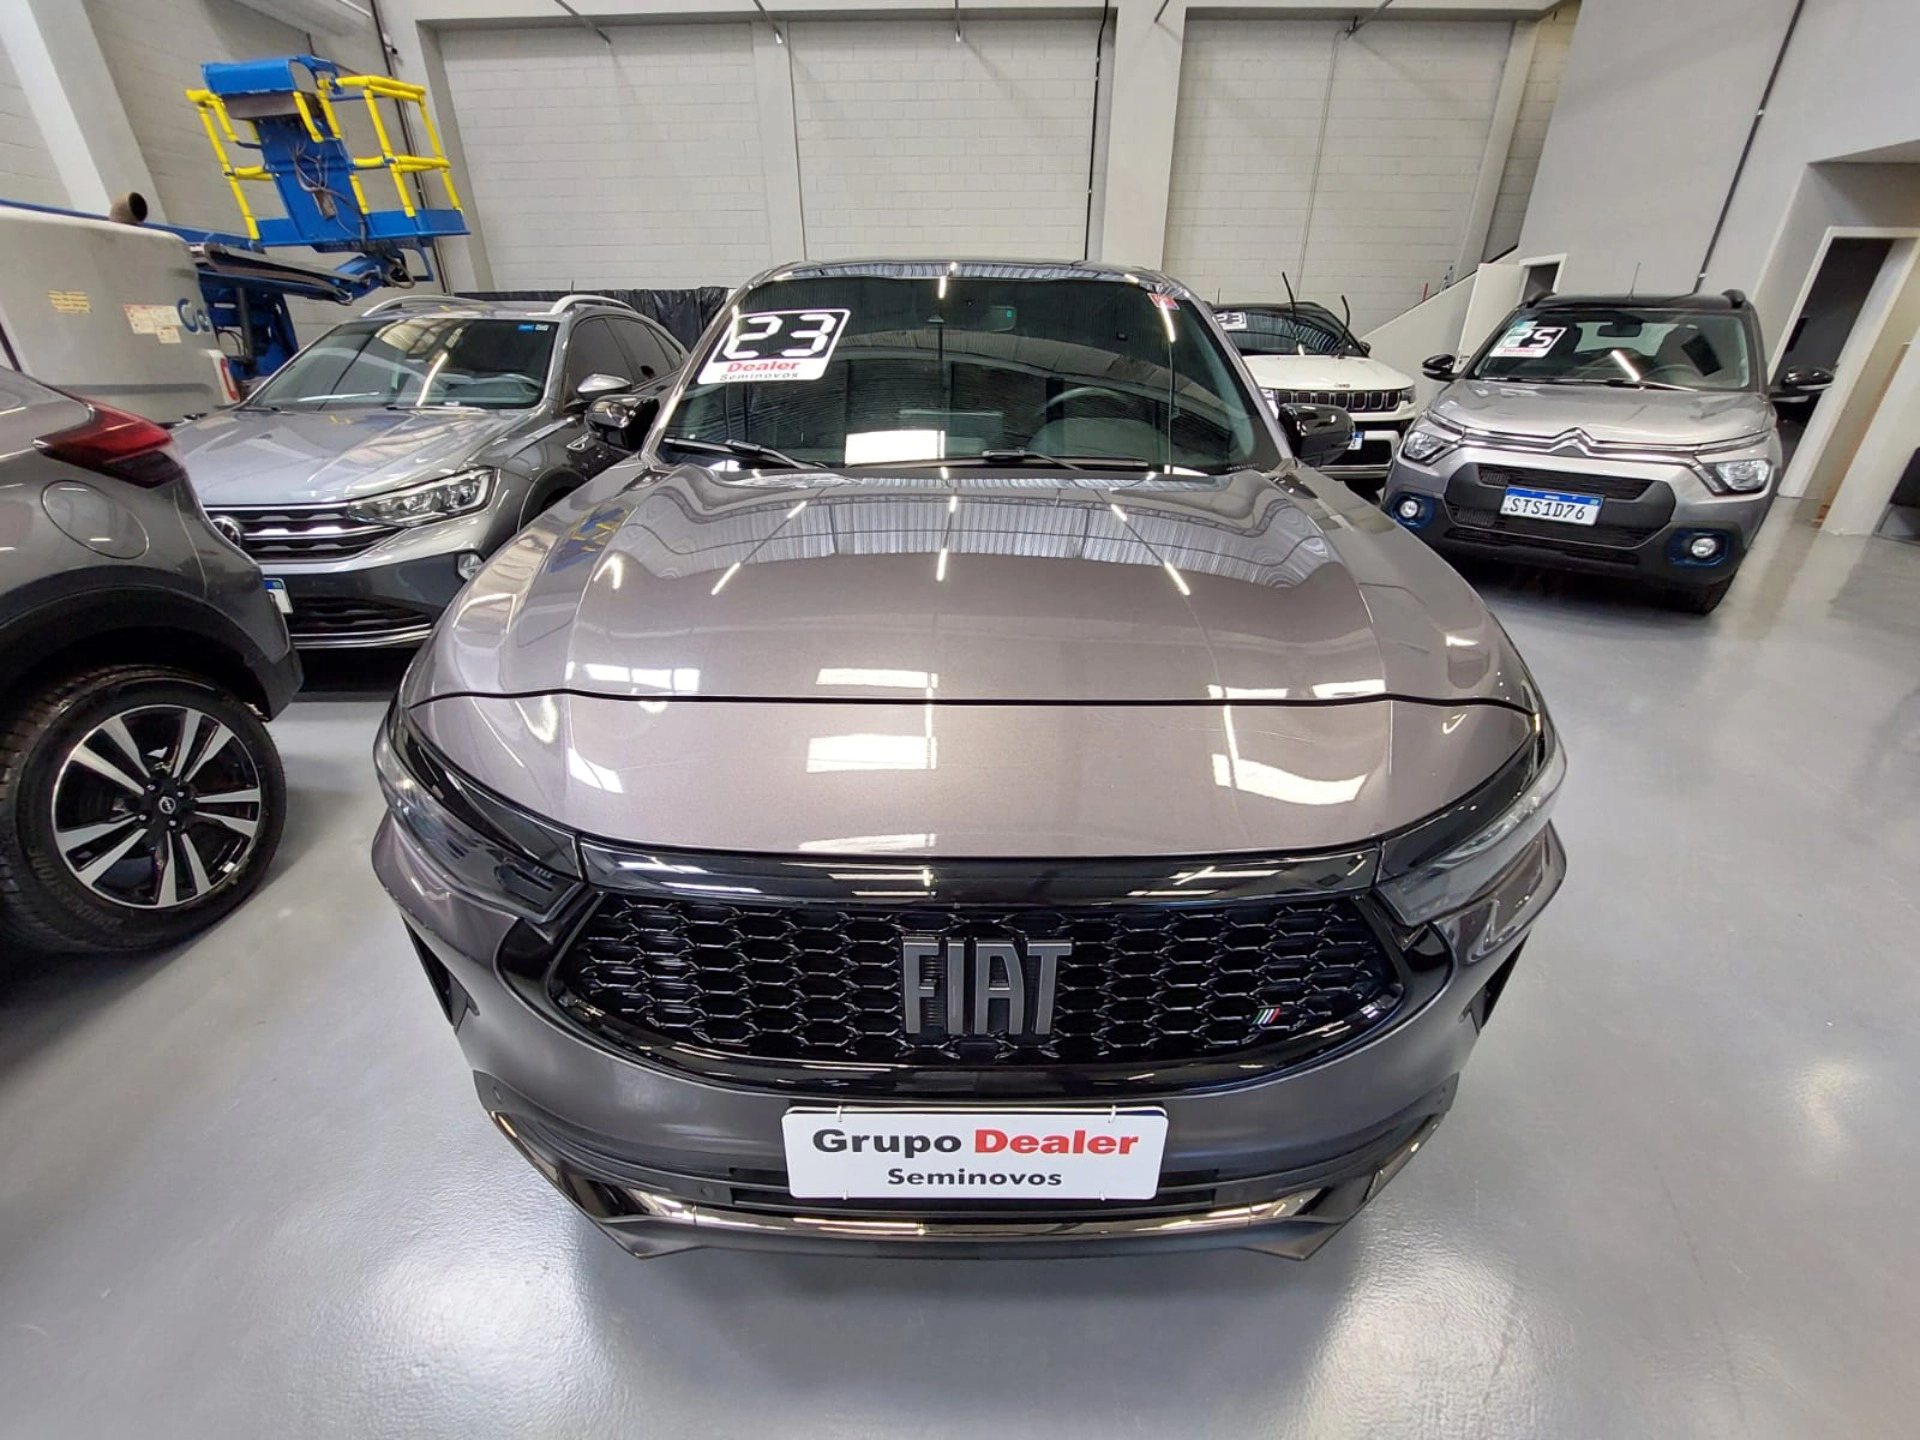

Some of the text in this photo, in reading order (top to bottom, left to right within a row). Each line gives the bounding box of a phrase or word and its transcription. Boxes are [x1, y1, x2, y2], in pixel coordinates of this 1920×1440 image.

[723, 313, 837, 360] 23
[719, 371, 799, 382] Seminovos
[726, 360, 801, 373] Dealer
[1509, 497, 1587, 520] STS1D76
[902, 936, 1073, 1036] FIAT
[812, 1128, 1140, 1159] Grupo Dealer
[887, 1167, 1062, 1187] Seminovos
